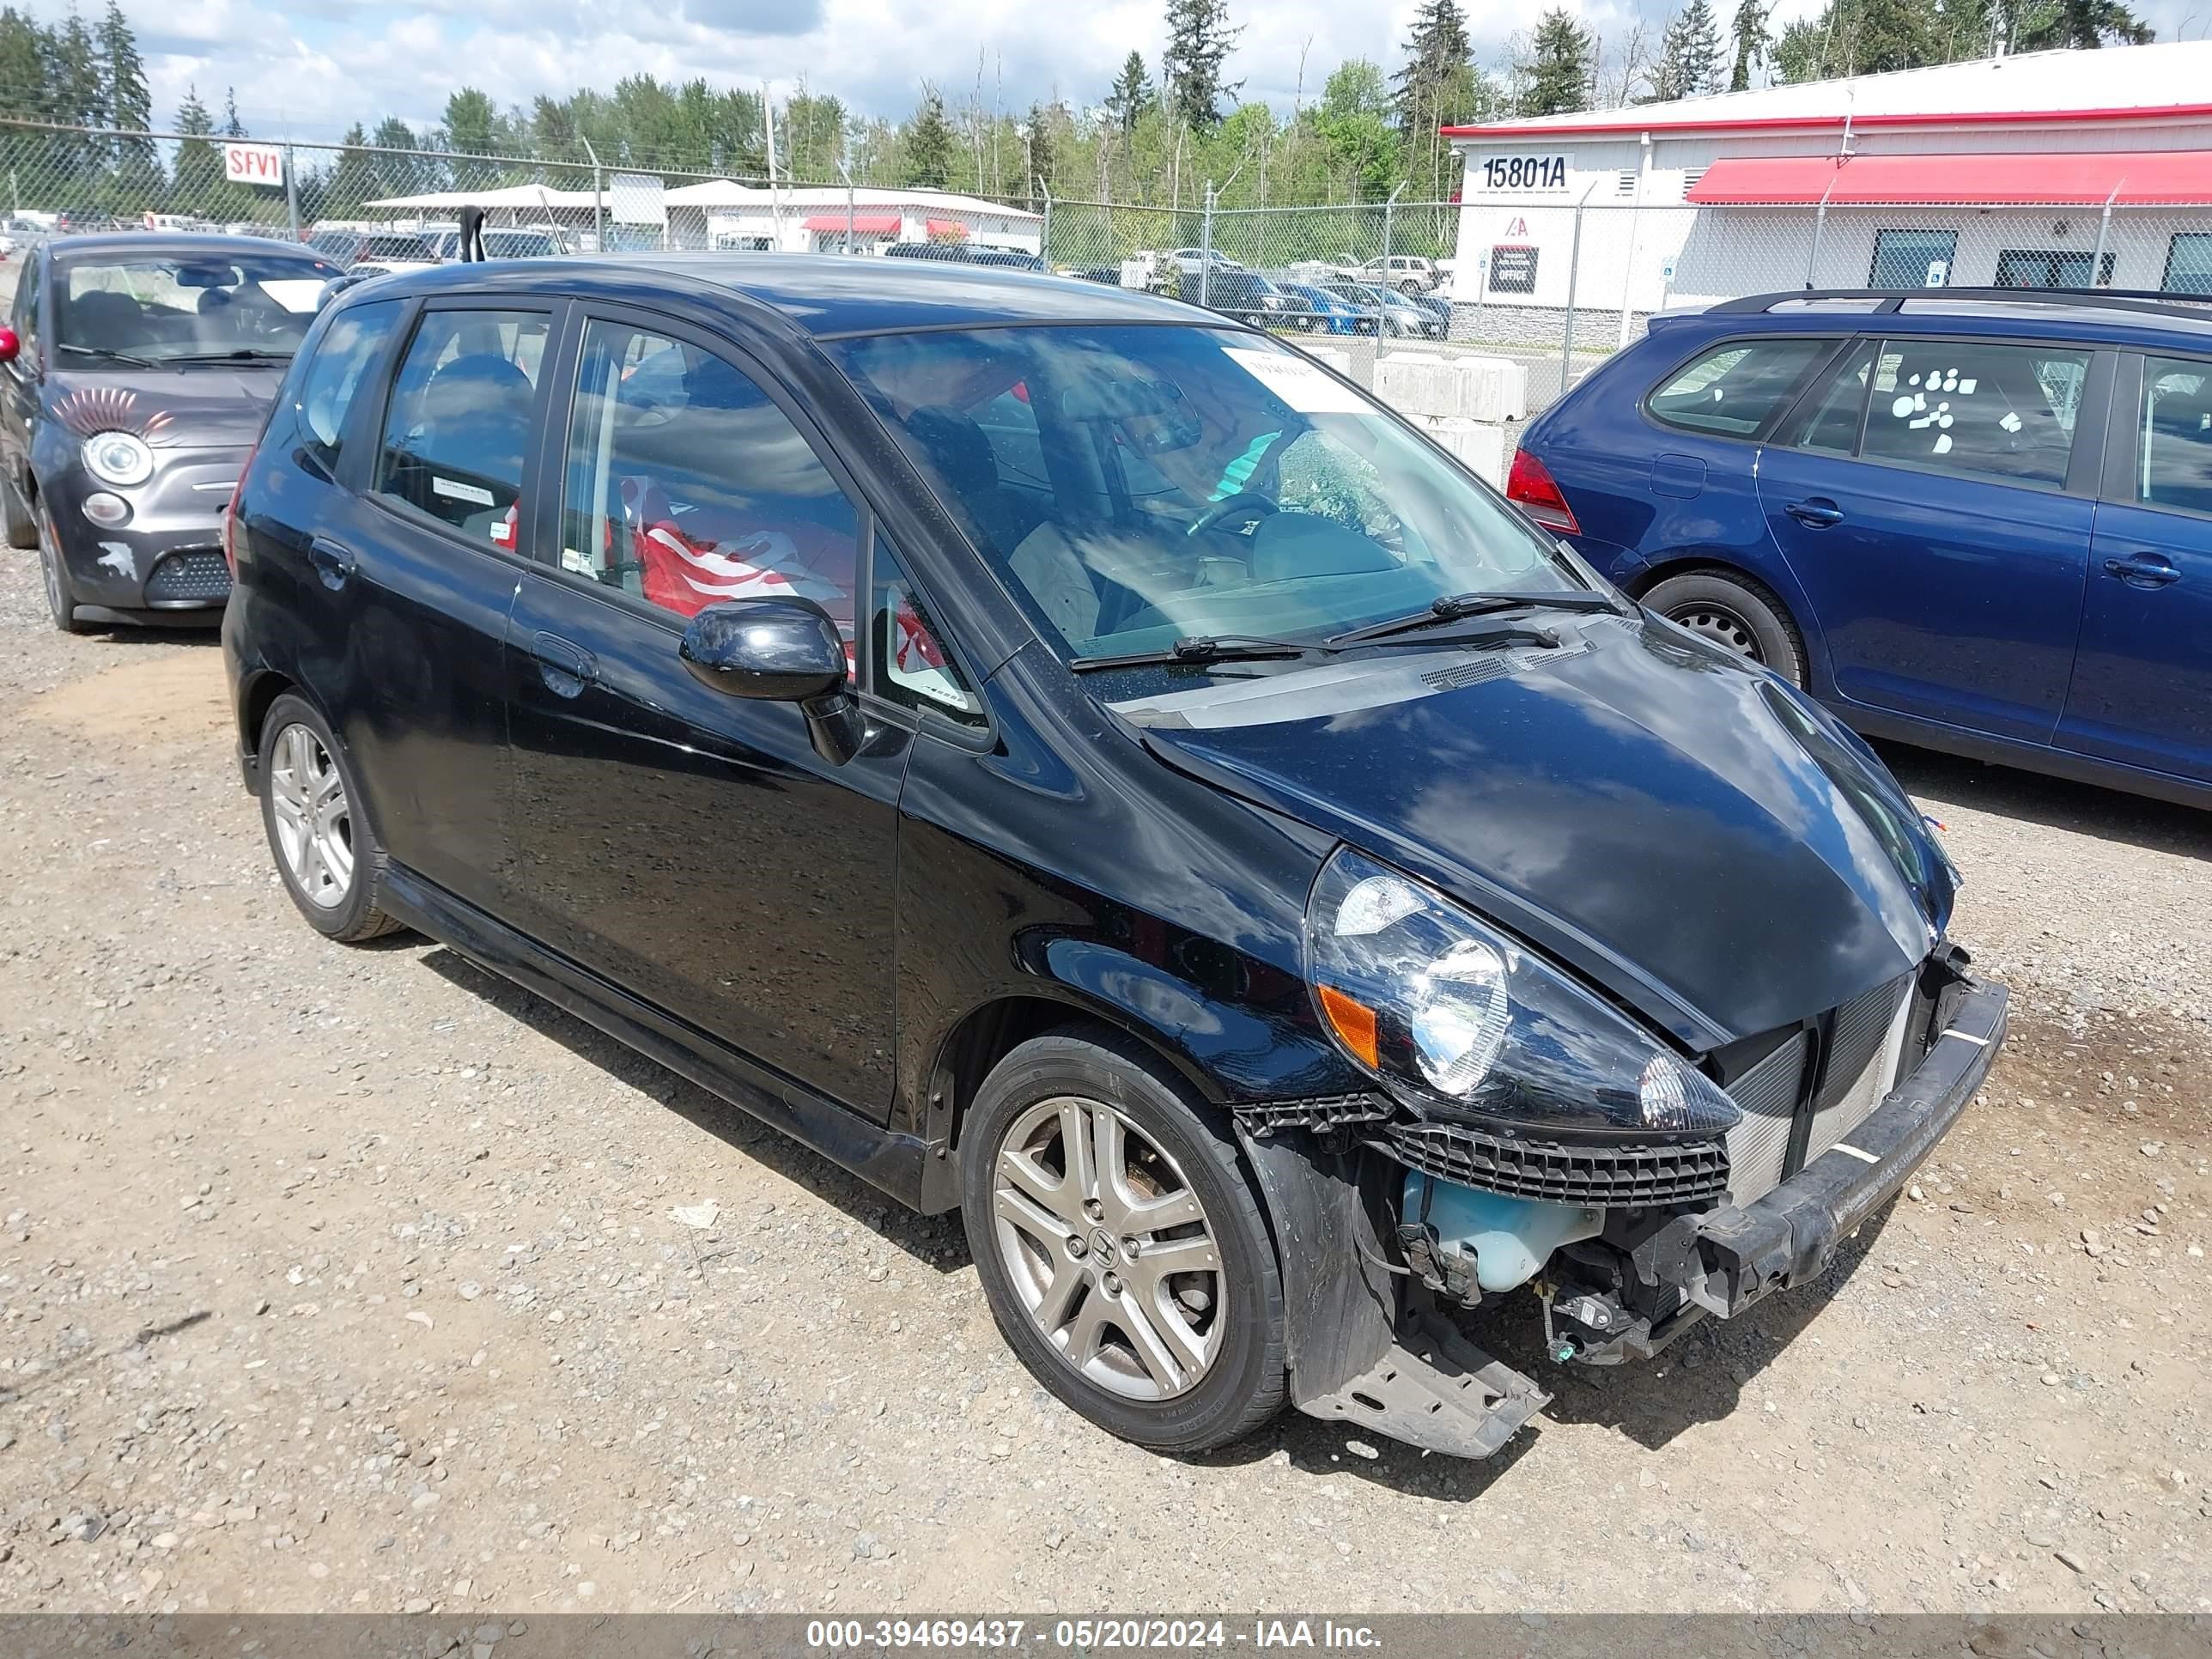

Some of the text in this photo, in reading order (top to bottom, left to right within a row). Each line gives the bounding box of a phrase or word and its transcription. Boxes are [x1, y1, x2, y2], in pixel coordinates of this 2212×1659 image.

[229, 149, 277, 179] SFV1
[1483, 156, 1565, 188] 15801A
[1499, 270, 1528, 281] OFFICE
